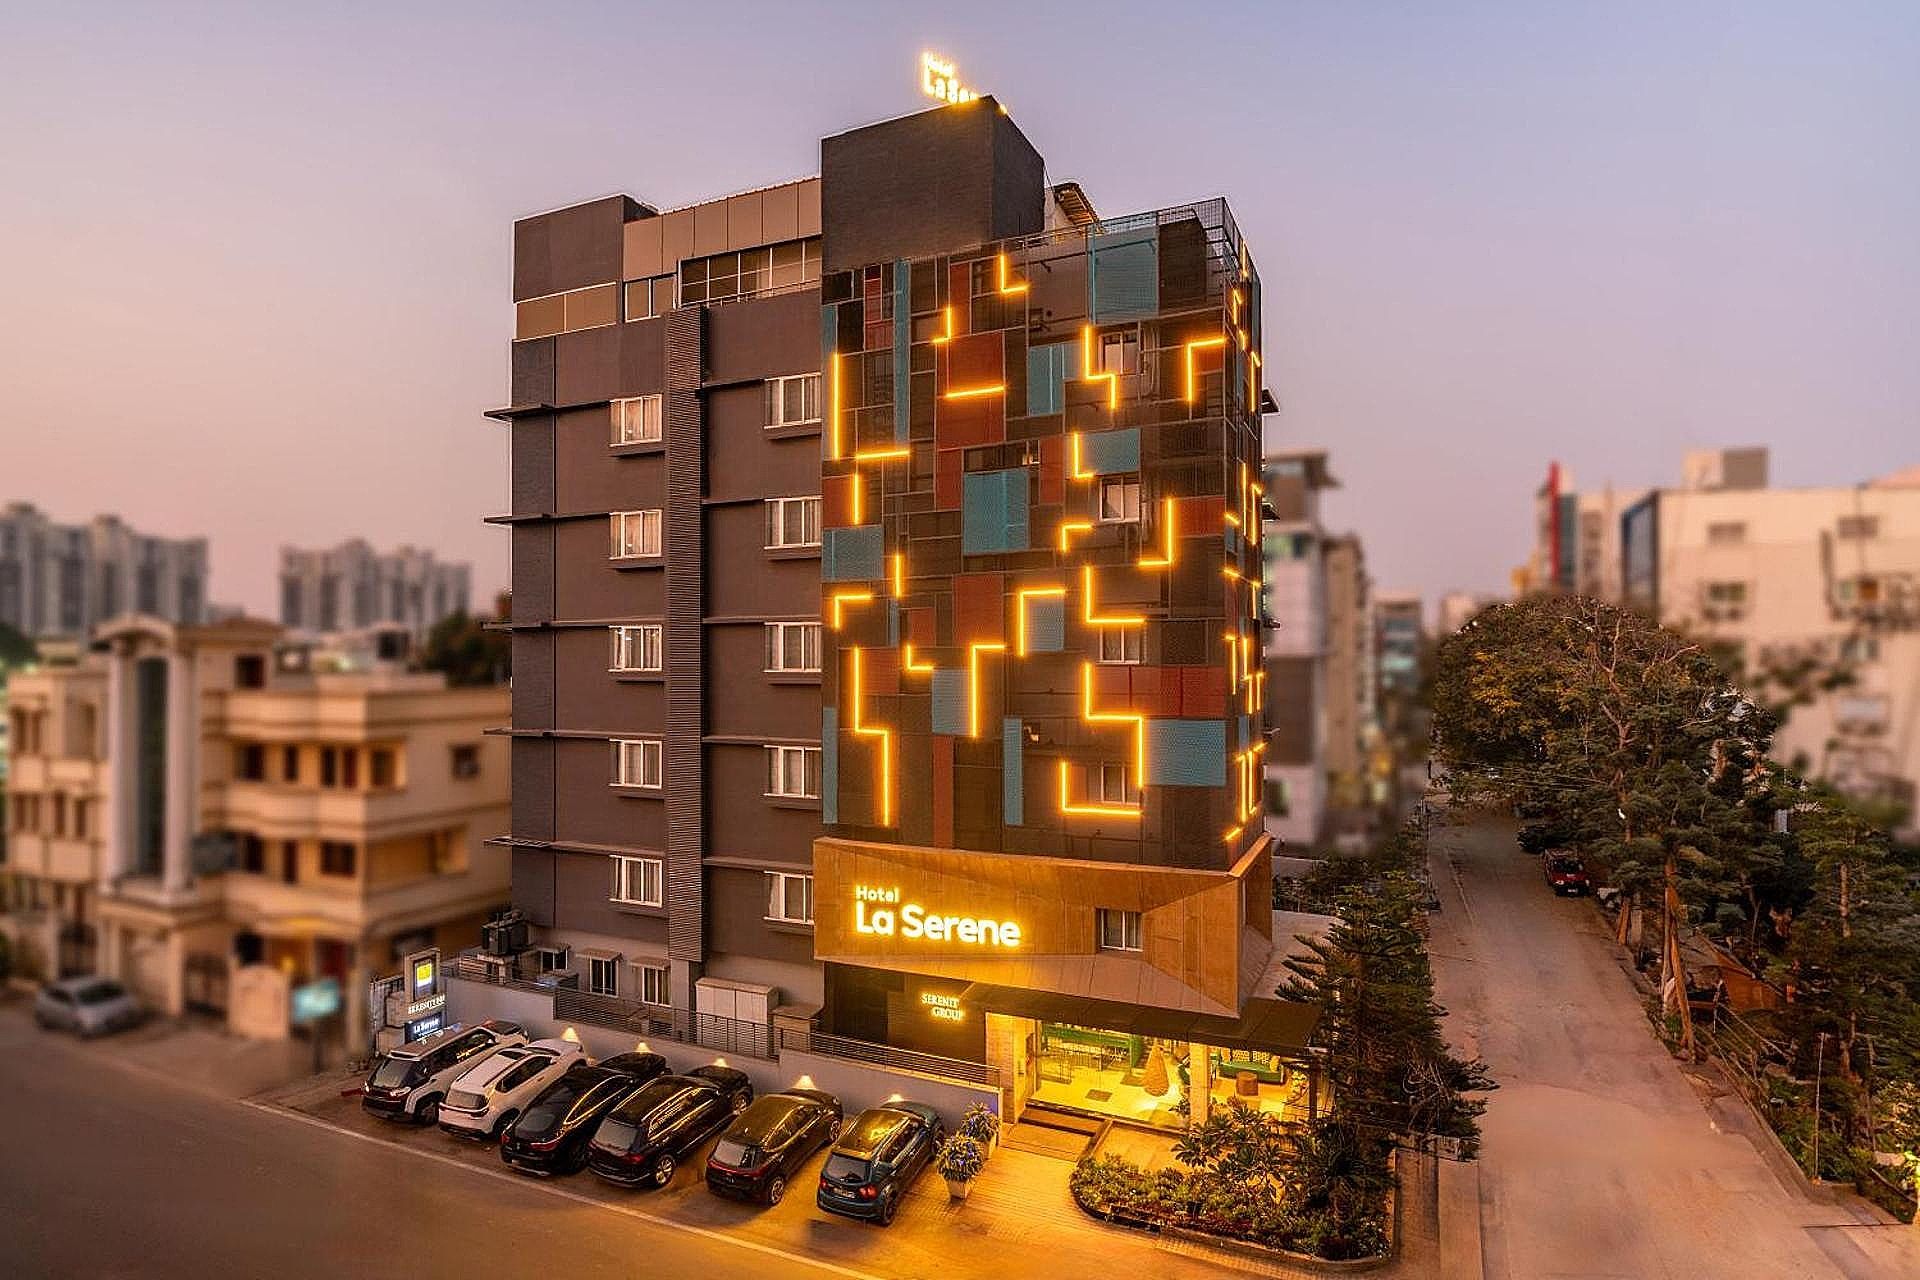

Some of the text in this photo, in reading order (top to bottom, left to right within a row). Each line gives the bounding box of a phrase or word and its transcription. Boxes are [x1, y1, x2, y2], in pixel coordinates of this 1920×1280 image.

[855, 884, 900, 903] Hotel
[855, 901, 1022, 947] La Serene
